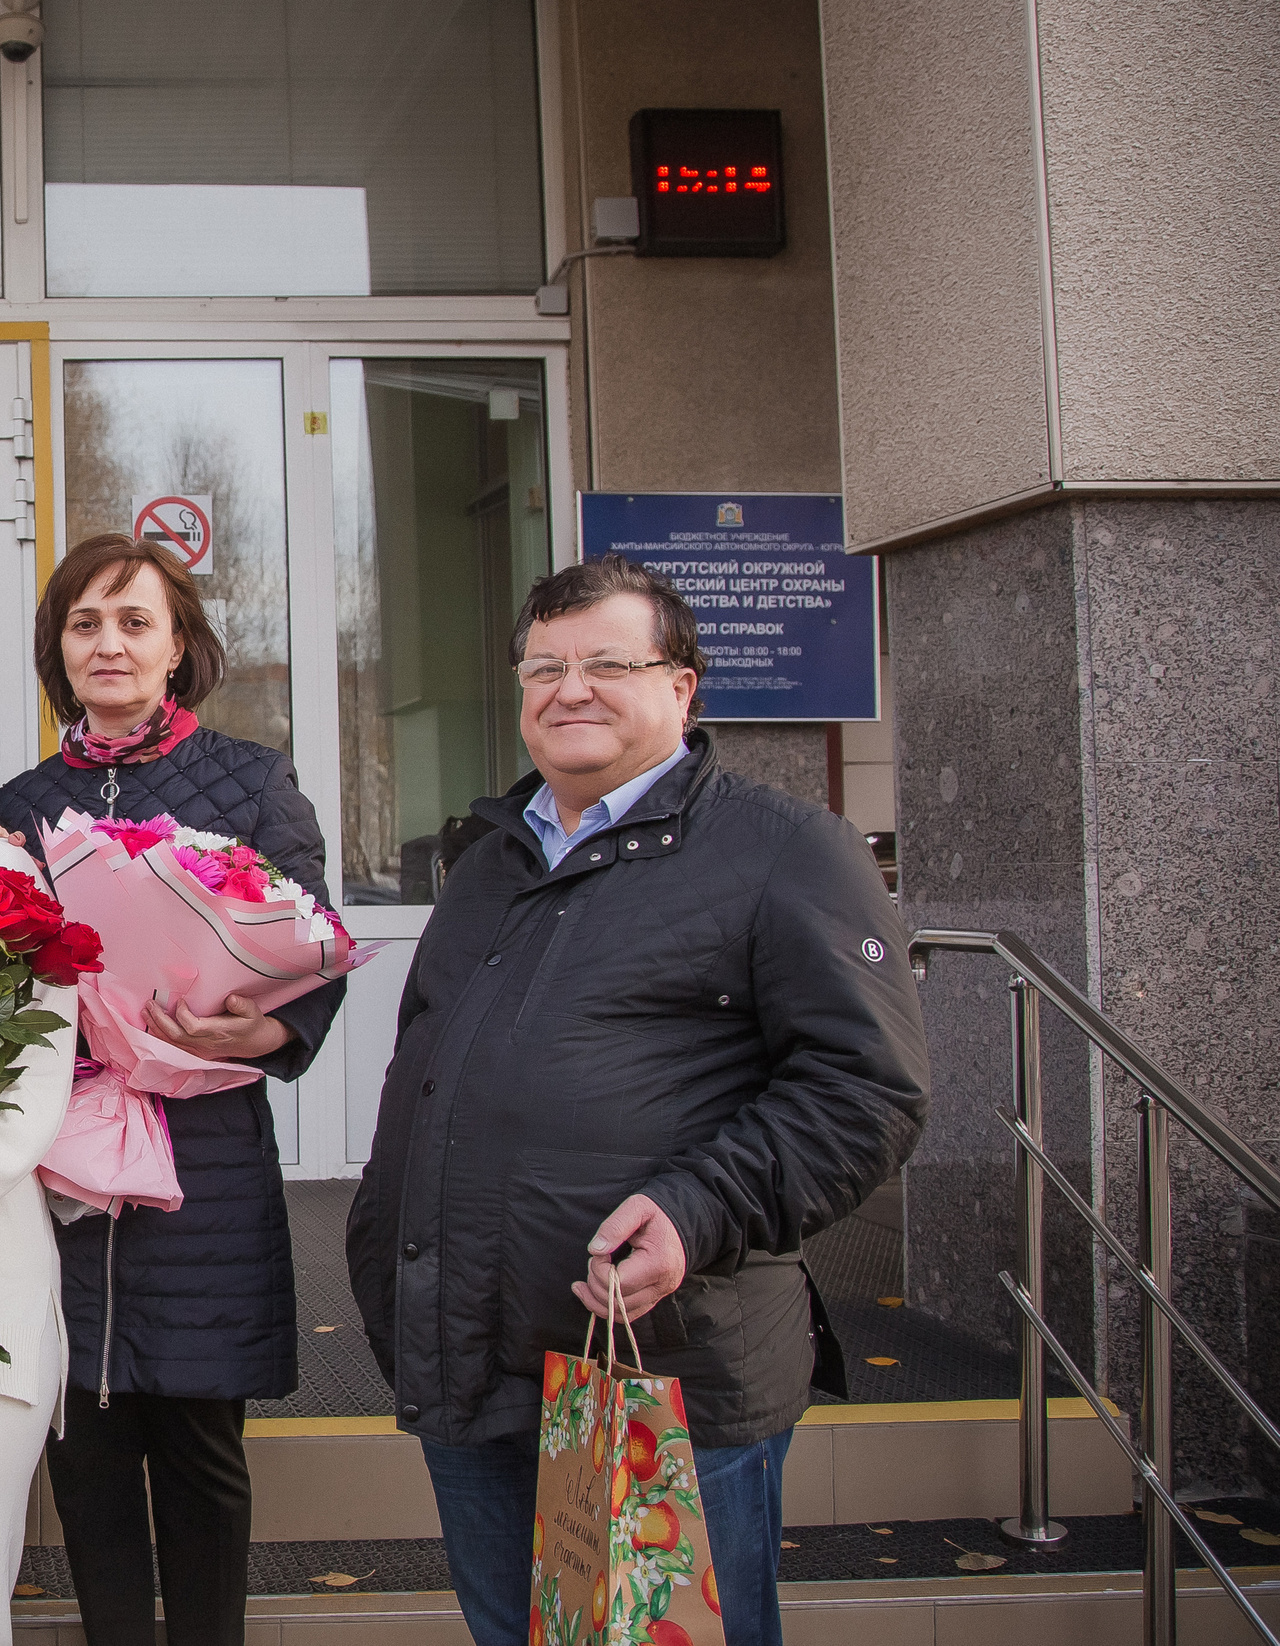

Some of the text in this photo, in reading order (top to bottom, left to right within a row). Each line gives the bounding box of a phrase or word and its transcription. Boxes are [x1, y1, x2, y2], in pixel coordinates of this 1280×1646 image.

[669, 532, 790, 542] БЮДЖЕТНОЕ УЧРЕЖДЕНИЕ
[782, 543, 814, 552] ОКРУГА
[742, 560, 825, 575] ОКРУЖНОЙ
[729, 579, 779, 592] ЦЕНТР
[782, 579, 845, 592] ОХРАНЫ
[743, 595, 753, 607] И
[756, 595, 832, 610] ДЕТСТВА»
[697, 623, 784, 635] ОЛ СПРАВОК
[743, 646, 769, 656] 08:00
[778, 647, 802, 656] 18:00
[715, 658, 774, 668] ВЫХОДНЫХ
